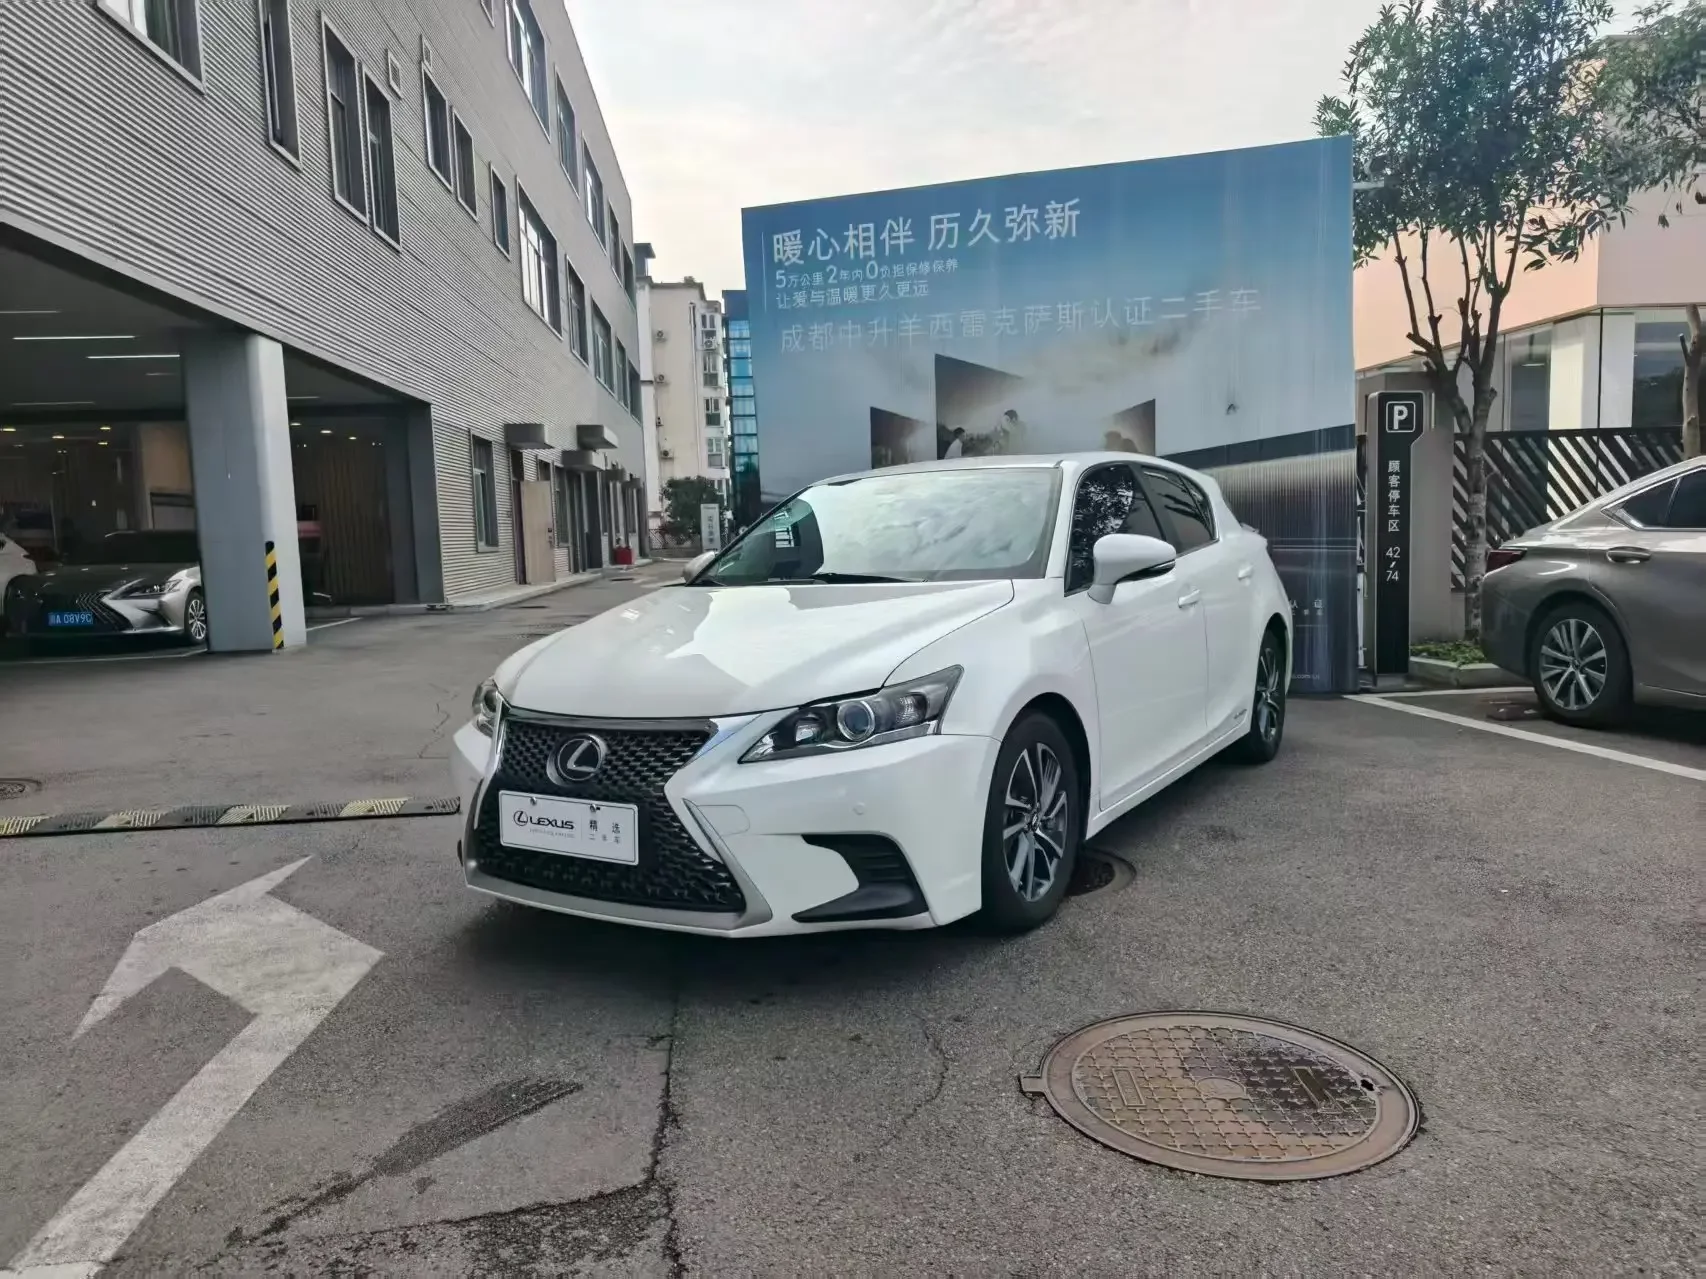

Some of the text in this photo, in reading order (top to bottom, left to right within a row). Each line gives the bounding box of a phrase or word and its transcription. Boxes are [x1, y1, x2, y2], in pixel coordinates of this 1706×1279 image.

[772, 198, 1080, 266] 暖心相伴 历久弥新
[775, 280, 930, 309] 让爱与温暖更久更远
[780, 286, 1261, 354] 成都中升羊西雷克萨斯认证二手车
[1392, 405, 1409, 429] P
[1387, 460, 1401, 532] 顾客停车区
[1385, 546, 1401, 558] 42
[1385, 570, 1400, 581] 74
[530, 815, 574, 830] LEXUS
